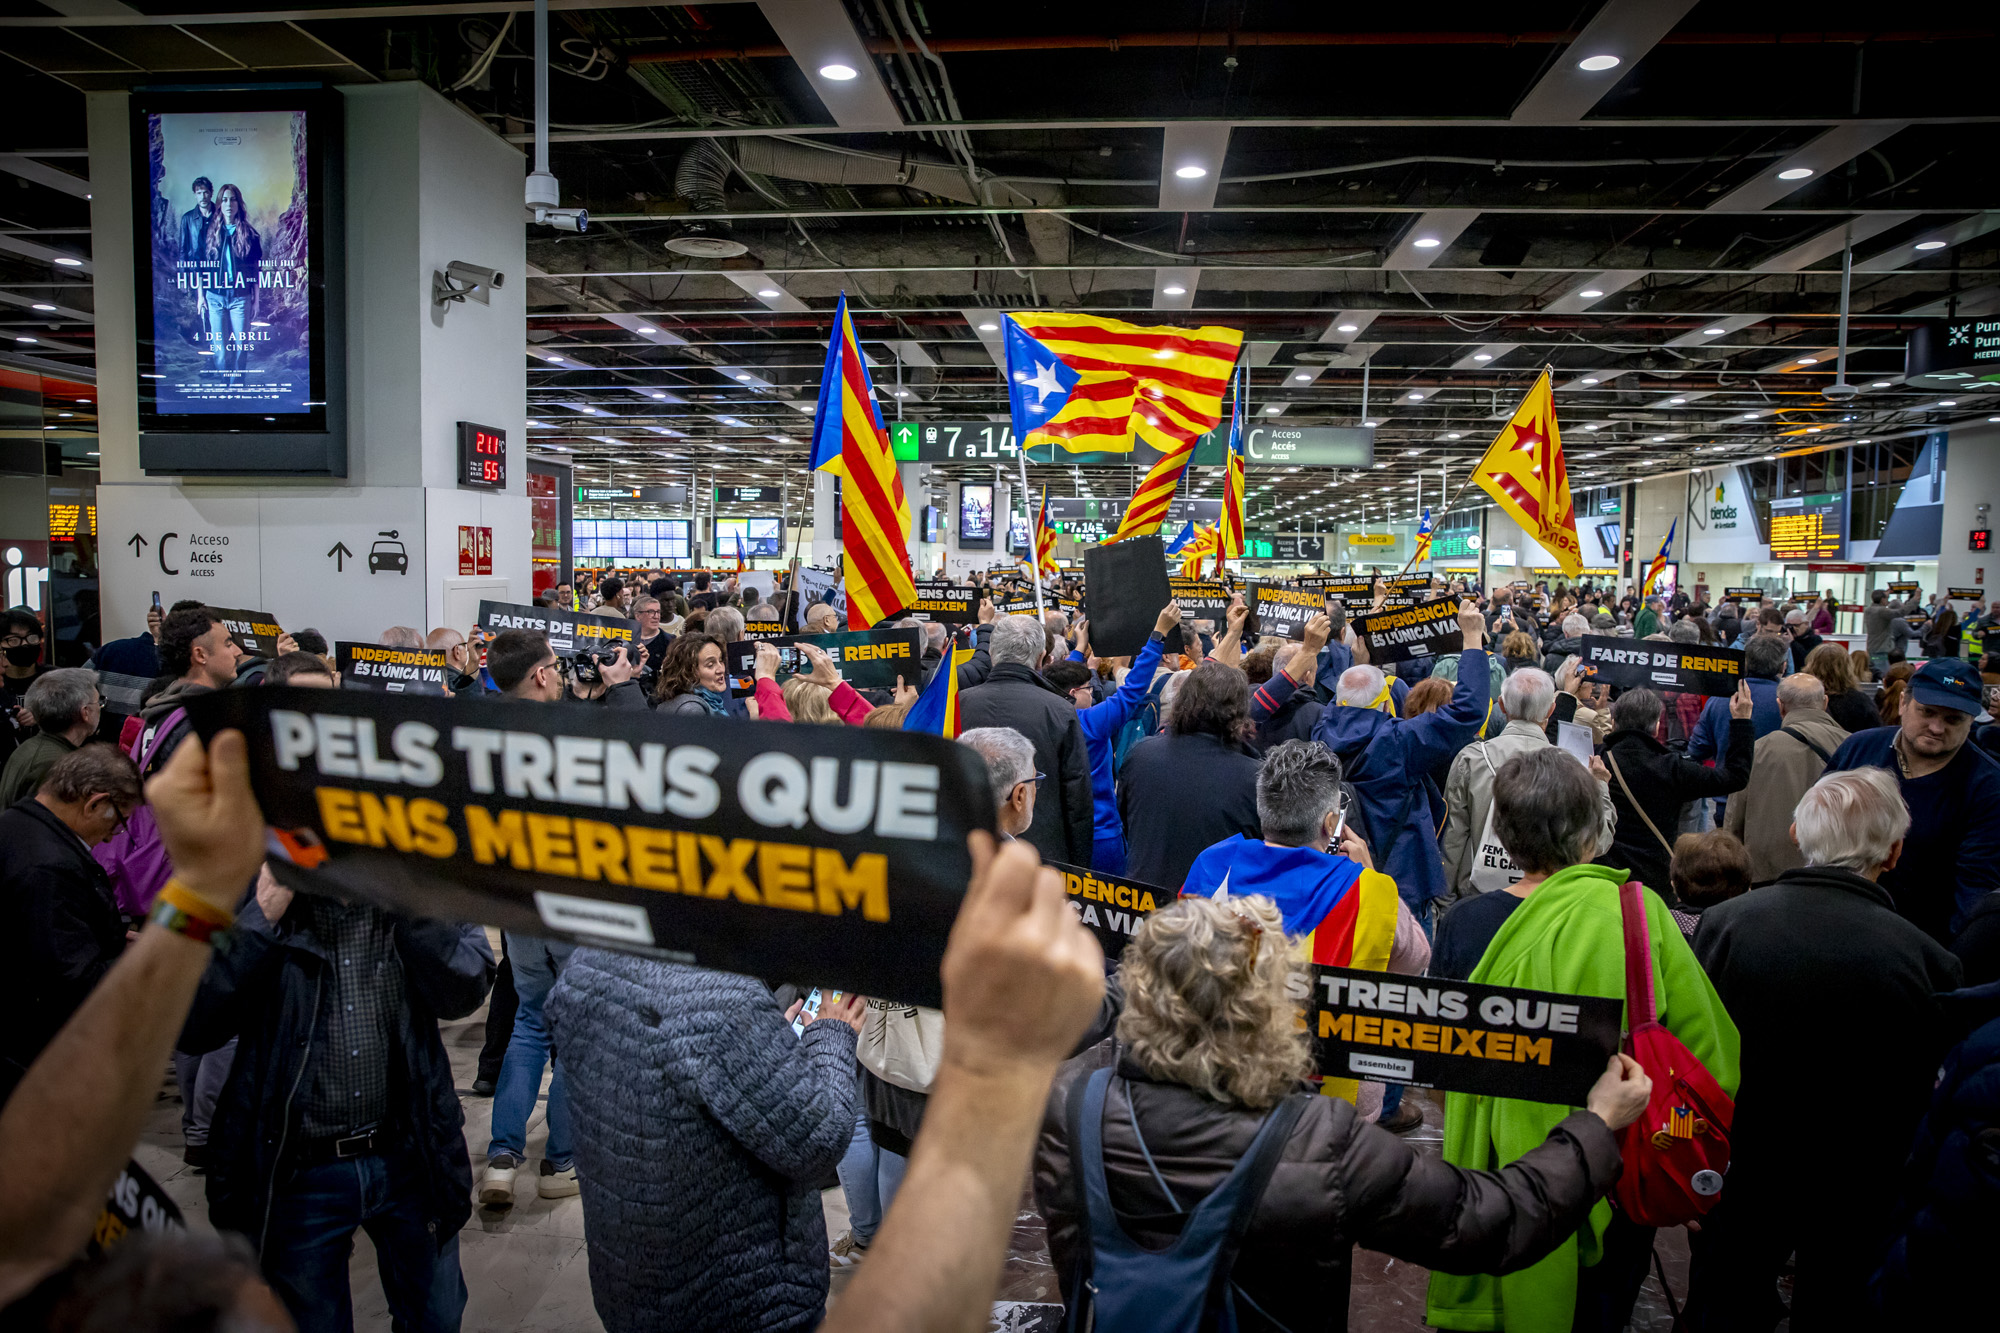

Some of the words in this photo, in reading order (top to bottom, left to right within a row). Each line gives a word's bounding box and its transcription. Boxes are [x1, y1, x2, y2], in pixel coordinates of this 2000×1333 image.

[258, 271, 294, 288] MAL
[192, 332, 199, 341] 4
[206, 332, 222, 341] DE
[229, 332, 271, 341] ABRIL
[944, 428, 962, 457] 7
[966, 444, 976, 458] a
[980, 427, 1017, 458] 14
[1248, 428, 1264, 458] C
[1272, 430, 1301, 440] Acceso
[1271, 441, 1296, 451] Accés
[484, 460, 498, 480] 55
[1710, 506, 1737, 521] tiendas
[1070, 523, 1076, 533] 7
[1082, 523, 1095, 533] 14
[190, 534, 230, 546] Acceso
[158, 532, 179, 575] C
[190, 551, 222, 563] Accés
[190, 568, 215, 577] ACCESS
[1302, 579, 1323, 587] PELS
[1324, 578, 1352, 586] TRENS
[946, 589, 973, 600] QUE
[1257, 588, 1325, 608] INDEPENDÈNCIA
[1006, 601, 1033, 611] TRENS
[1207, 600, 1225, 608] VIA
[1257, 604, 1268, 616] ÉS
[1366, 601, 1460, 632] INDEPENDÈNCIA
[238, 621, 253, 635] DE
[489, 614, 546, 630] FARTS
[550, 621, 573, 635] DE
[577, 624, 632, 641] RENFE
[1371, 633, 1385, 648] ÉS
[1385, 624, 1434, 645] L'ÚNICA
[1433, 618, 1461, 636] VIA
[352, 647, 446, 666] INDEPENDÈNCIA
[845, 642, 910, 661] RENFE
[1590, 648, 1649, 666] FARTS
[1652, 653, 1678, 668] DE
[1681, 655, 1739, 675] RENFE
[354, 662, 370, 675] ÉS
[372, 662, 419, 680] L'ÚNICA
[422, 669, 442, 682] VIA
[268, 709, 445, 788] PELS
[451, 725, 721, 820] TRENS
[737, 751, 940, 841] QUE
[314, 786, 458, 859] ENS
[465, 805, 891, 923] MEREIXEM
[1484, 855, 1497, 869] EL
[1320, 975, 1468, 1021] TRENS
[1479, 996, 1580, 1034] QUE
[1318, 1010, 1553, 1066] MEREIXEM
[1358, 1059, 1406, 1072] assemblea
